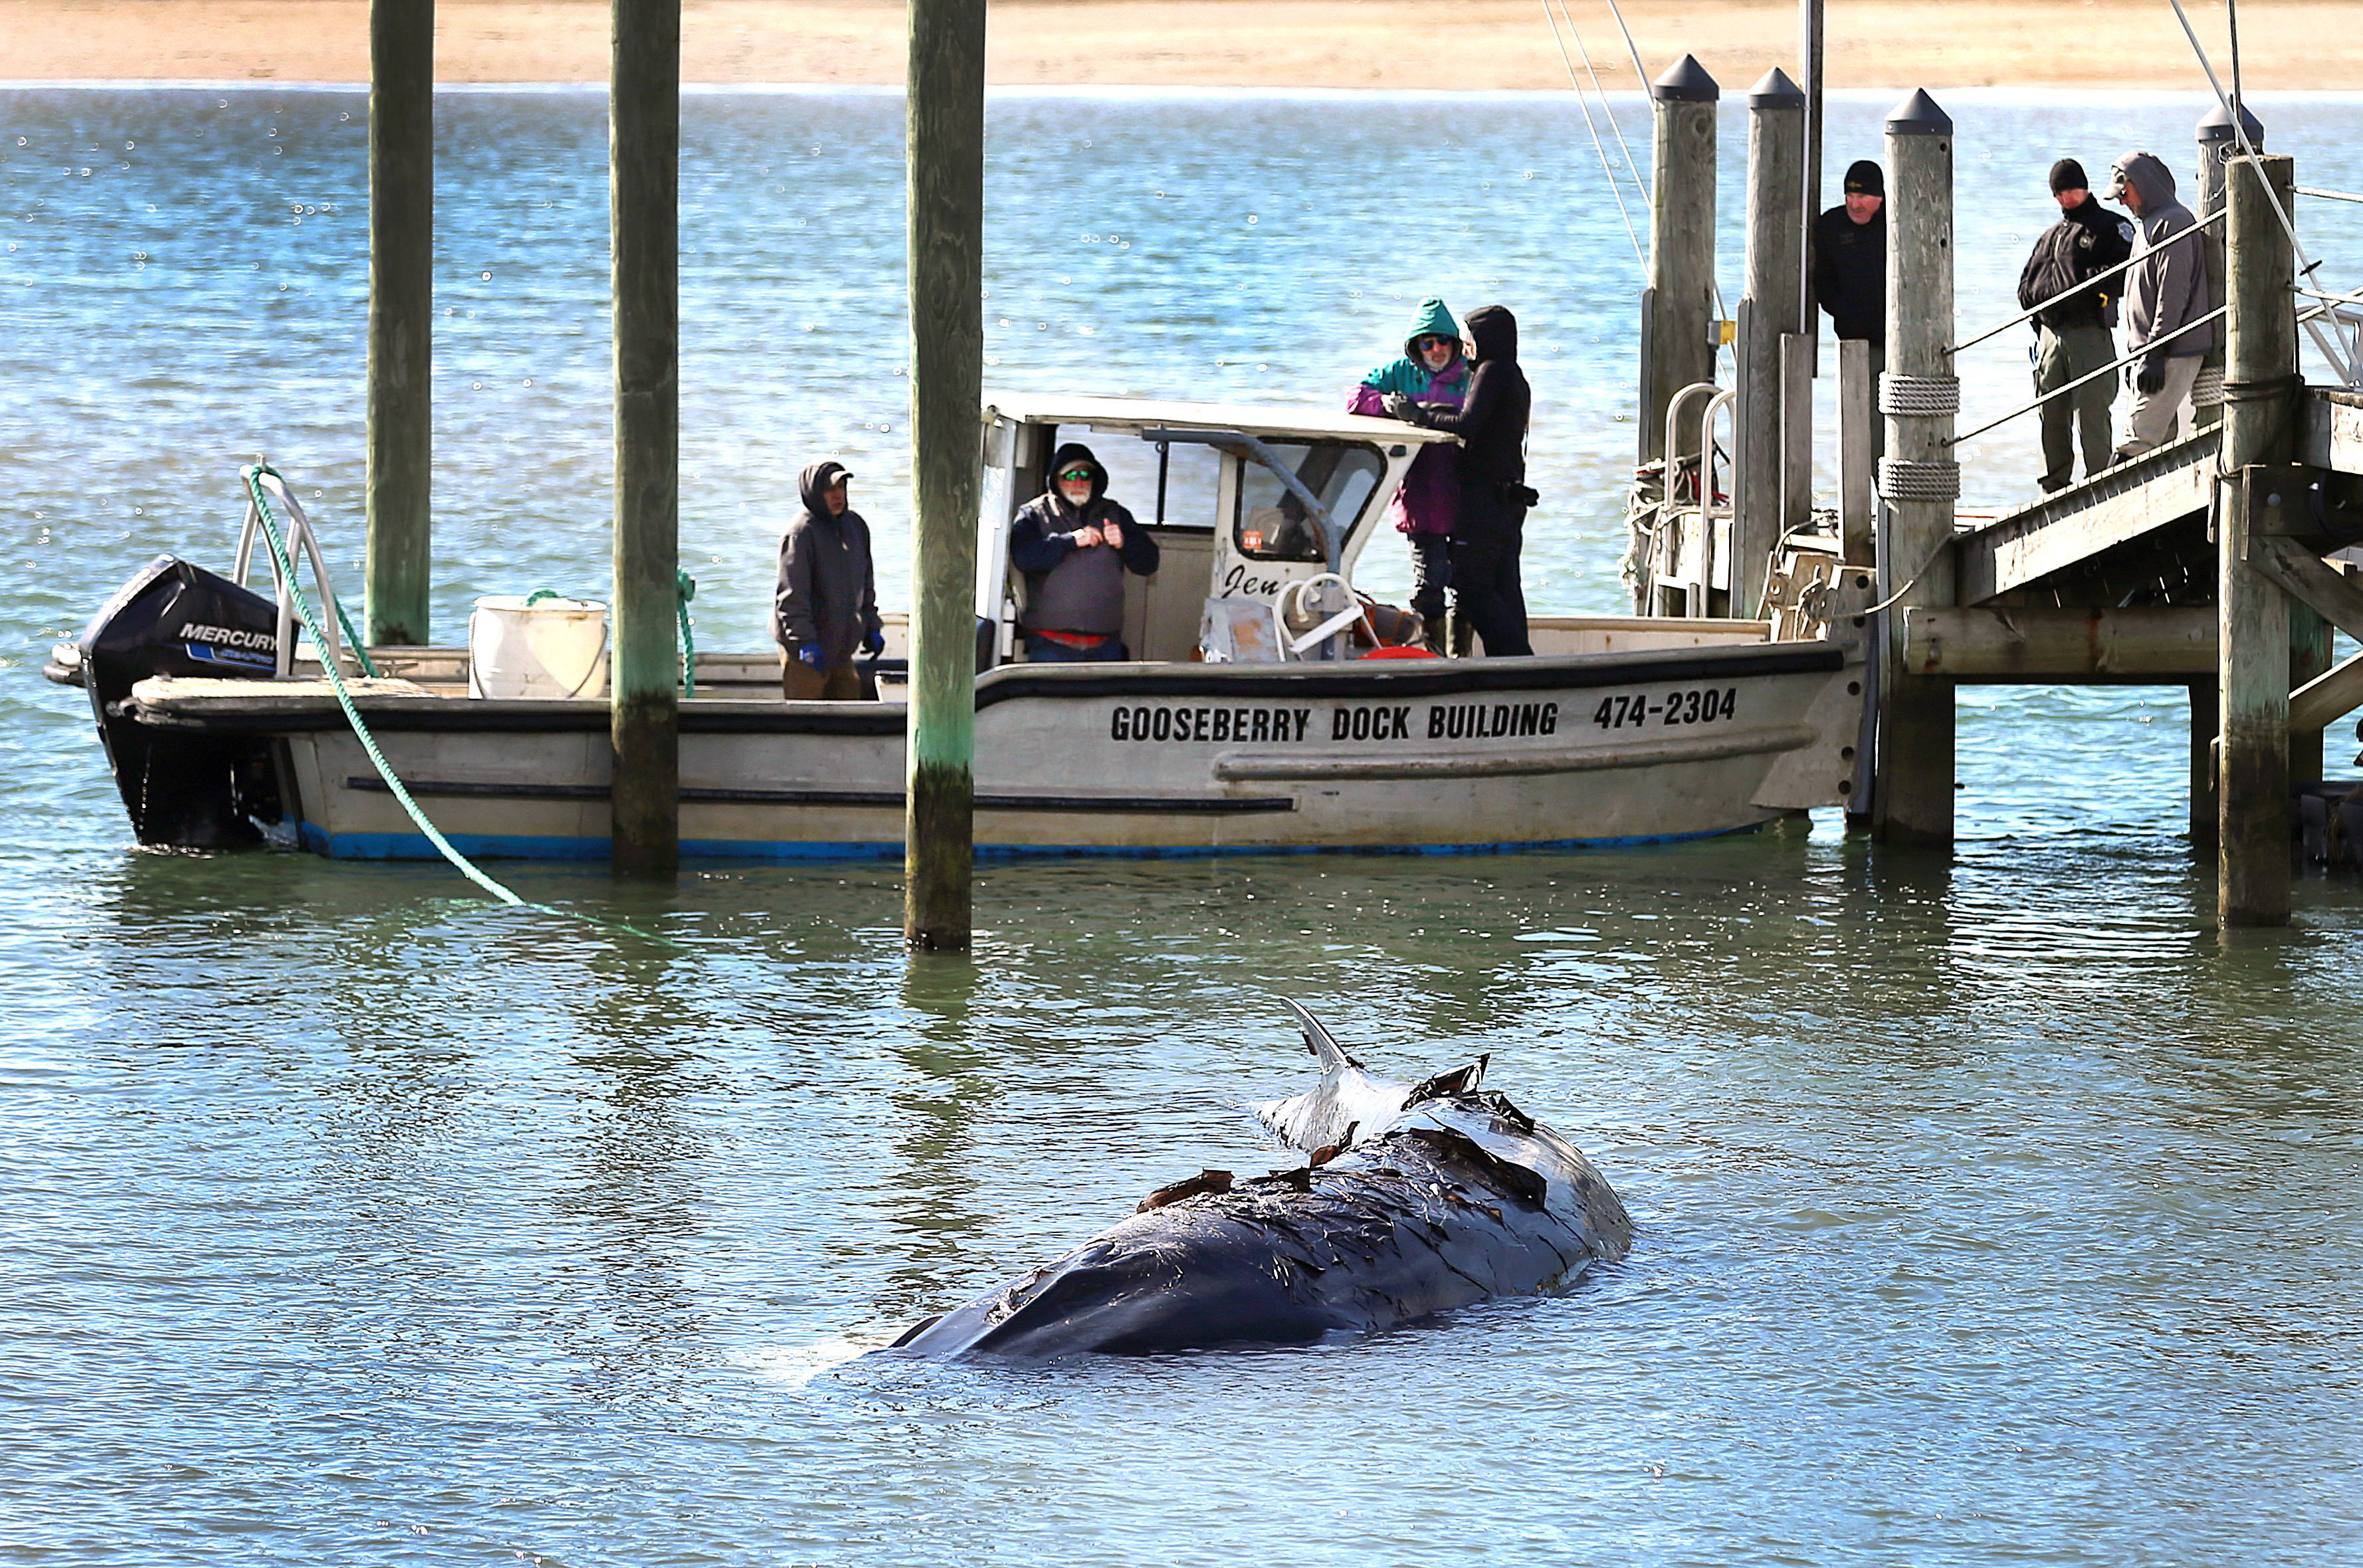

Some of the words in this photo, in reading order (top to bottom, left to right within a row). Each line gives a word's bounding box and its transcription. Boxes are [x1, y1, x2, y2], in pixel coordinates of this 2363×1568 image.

[179, 622, 277, 651] MERCURY
[1111, 706, 1311, 742] GOOSEBERRY
[1332, 706, 1411, 741] DOCK
[1427, 702, 1558, 739] BUILDING
[1593, 688, 1737, 730] 474-2304
